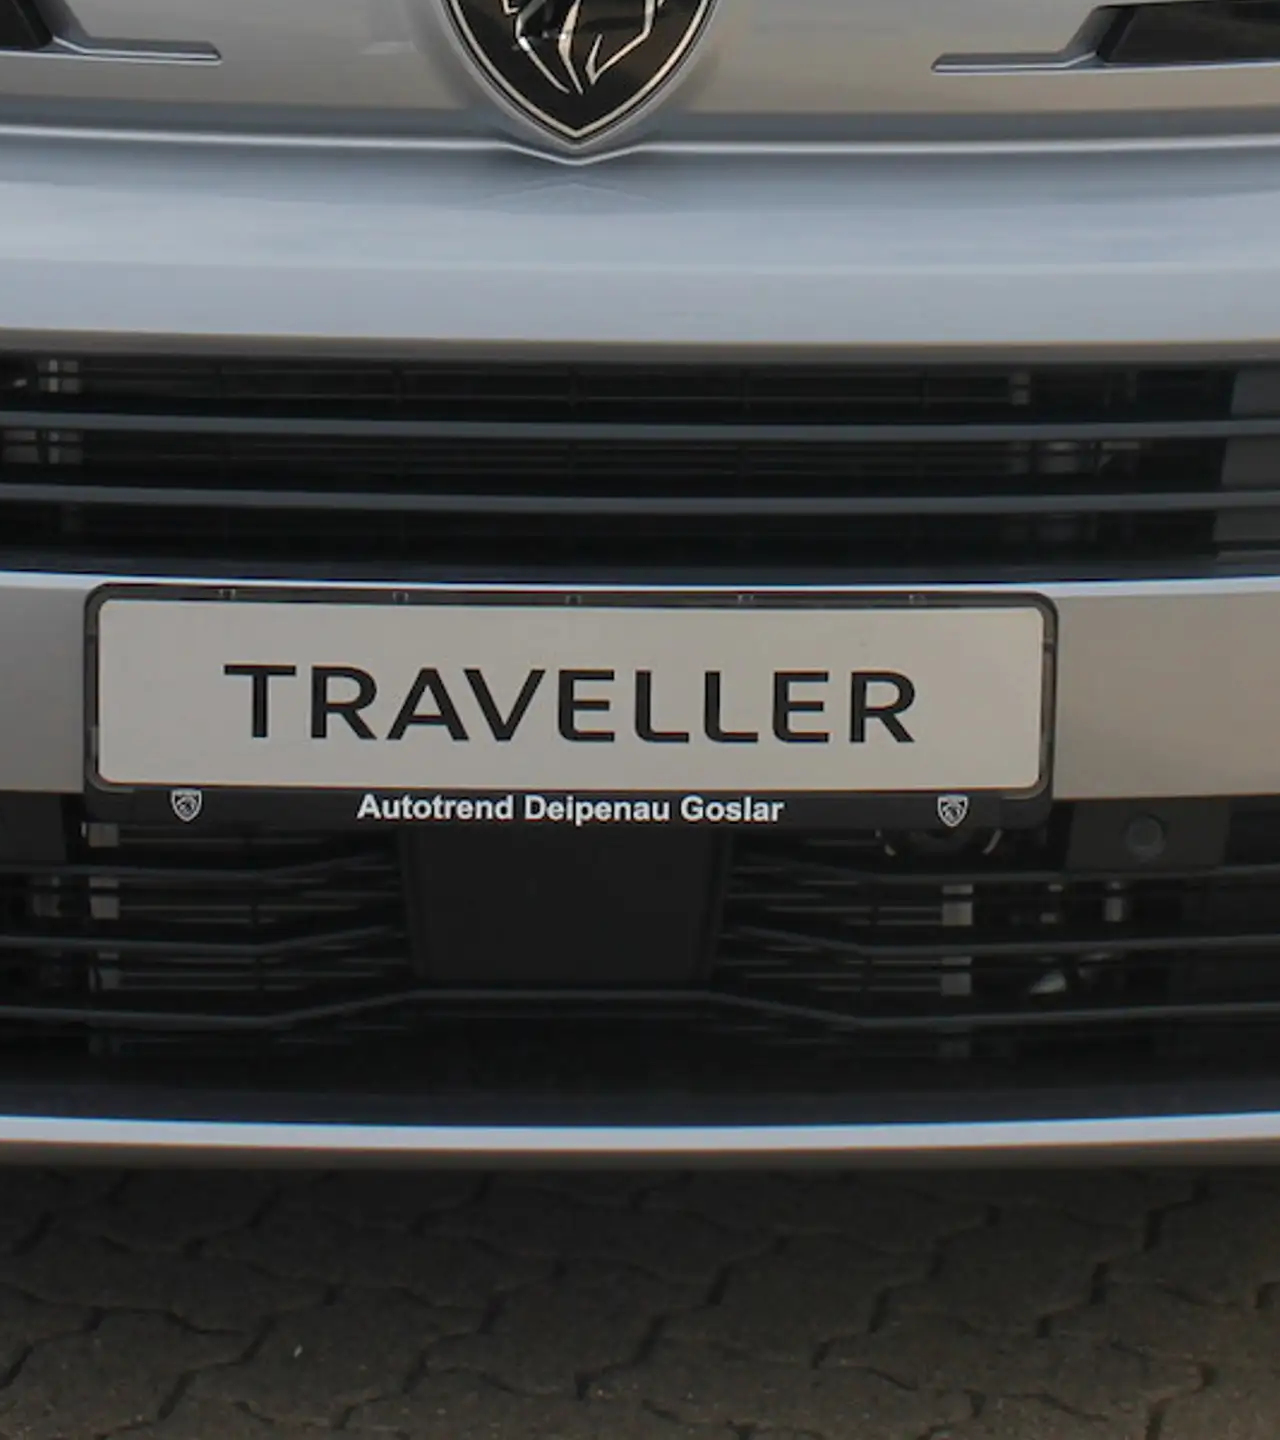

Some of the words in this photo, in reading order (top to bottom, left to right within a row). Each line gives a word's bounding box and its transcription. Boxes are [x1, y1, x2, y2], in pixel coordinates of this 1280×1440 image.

[223, 663, 918, 744] TRAVELLER
[356, 793, 515, 821] Autotrend
[523, 794, 671, 827] Deipenau
[680, 796, 786, 823] Goslar
